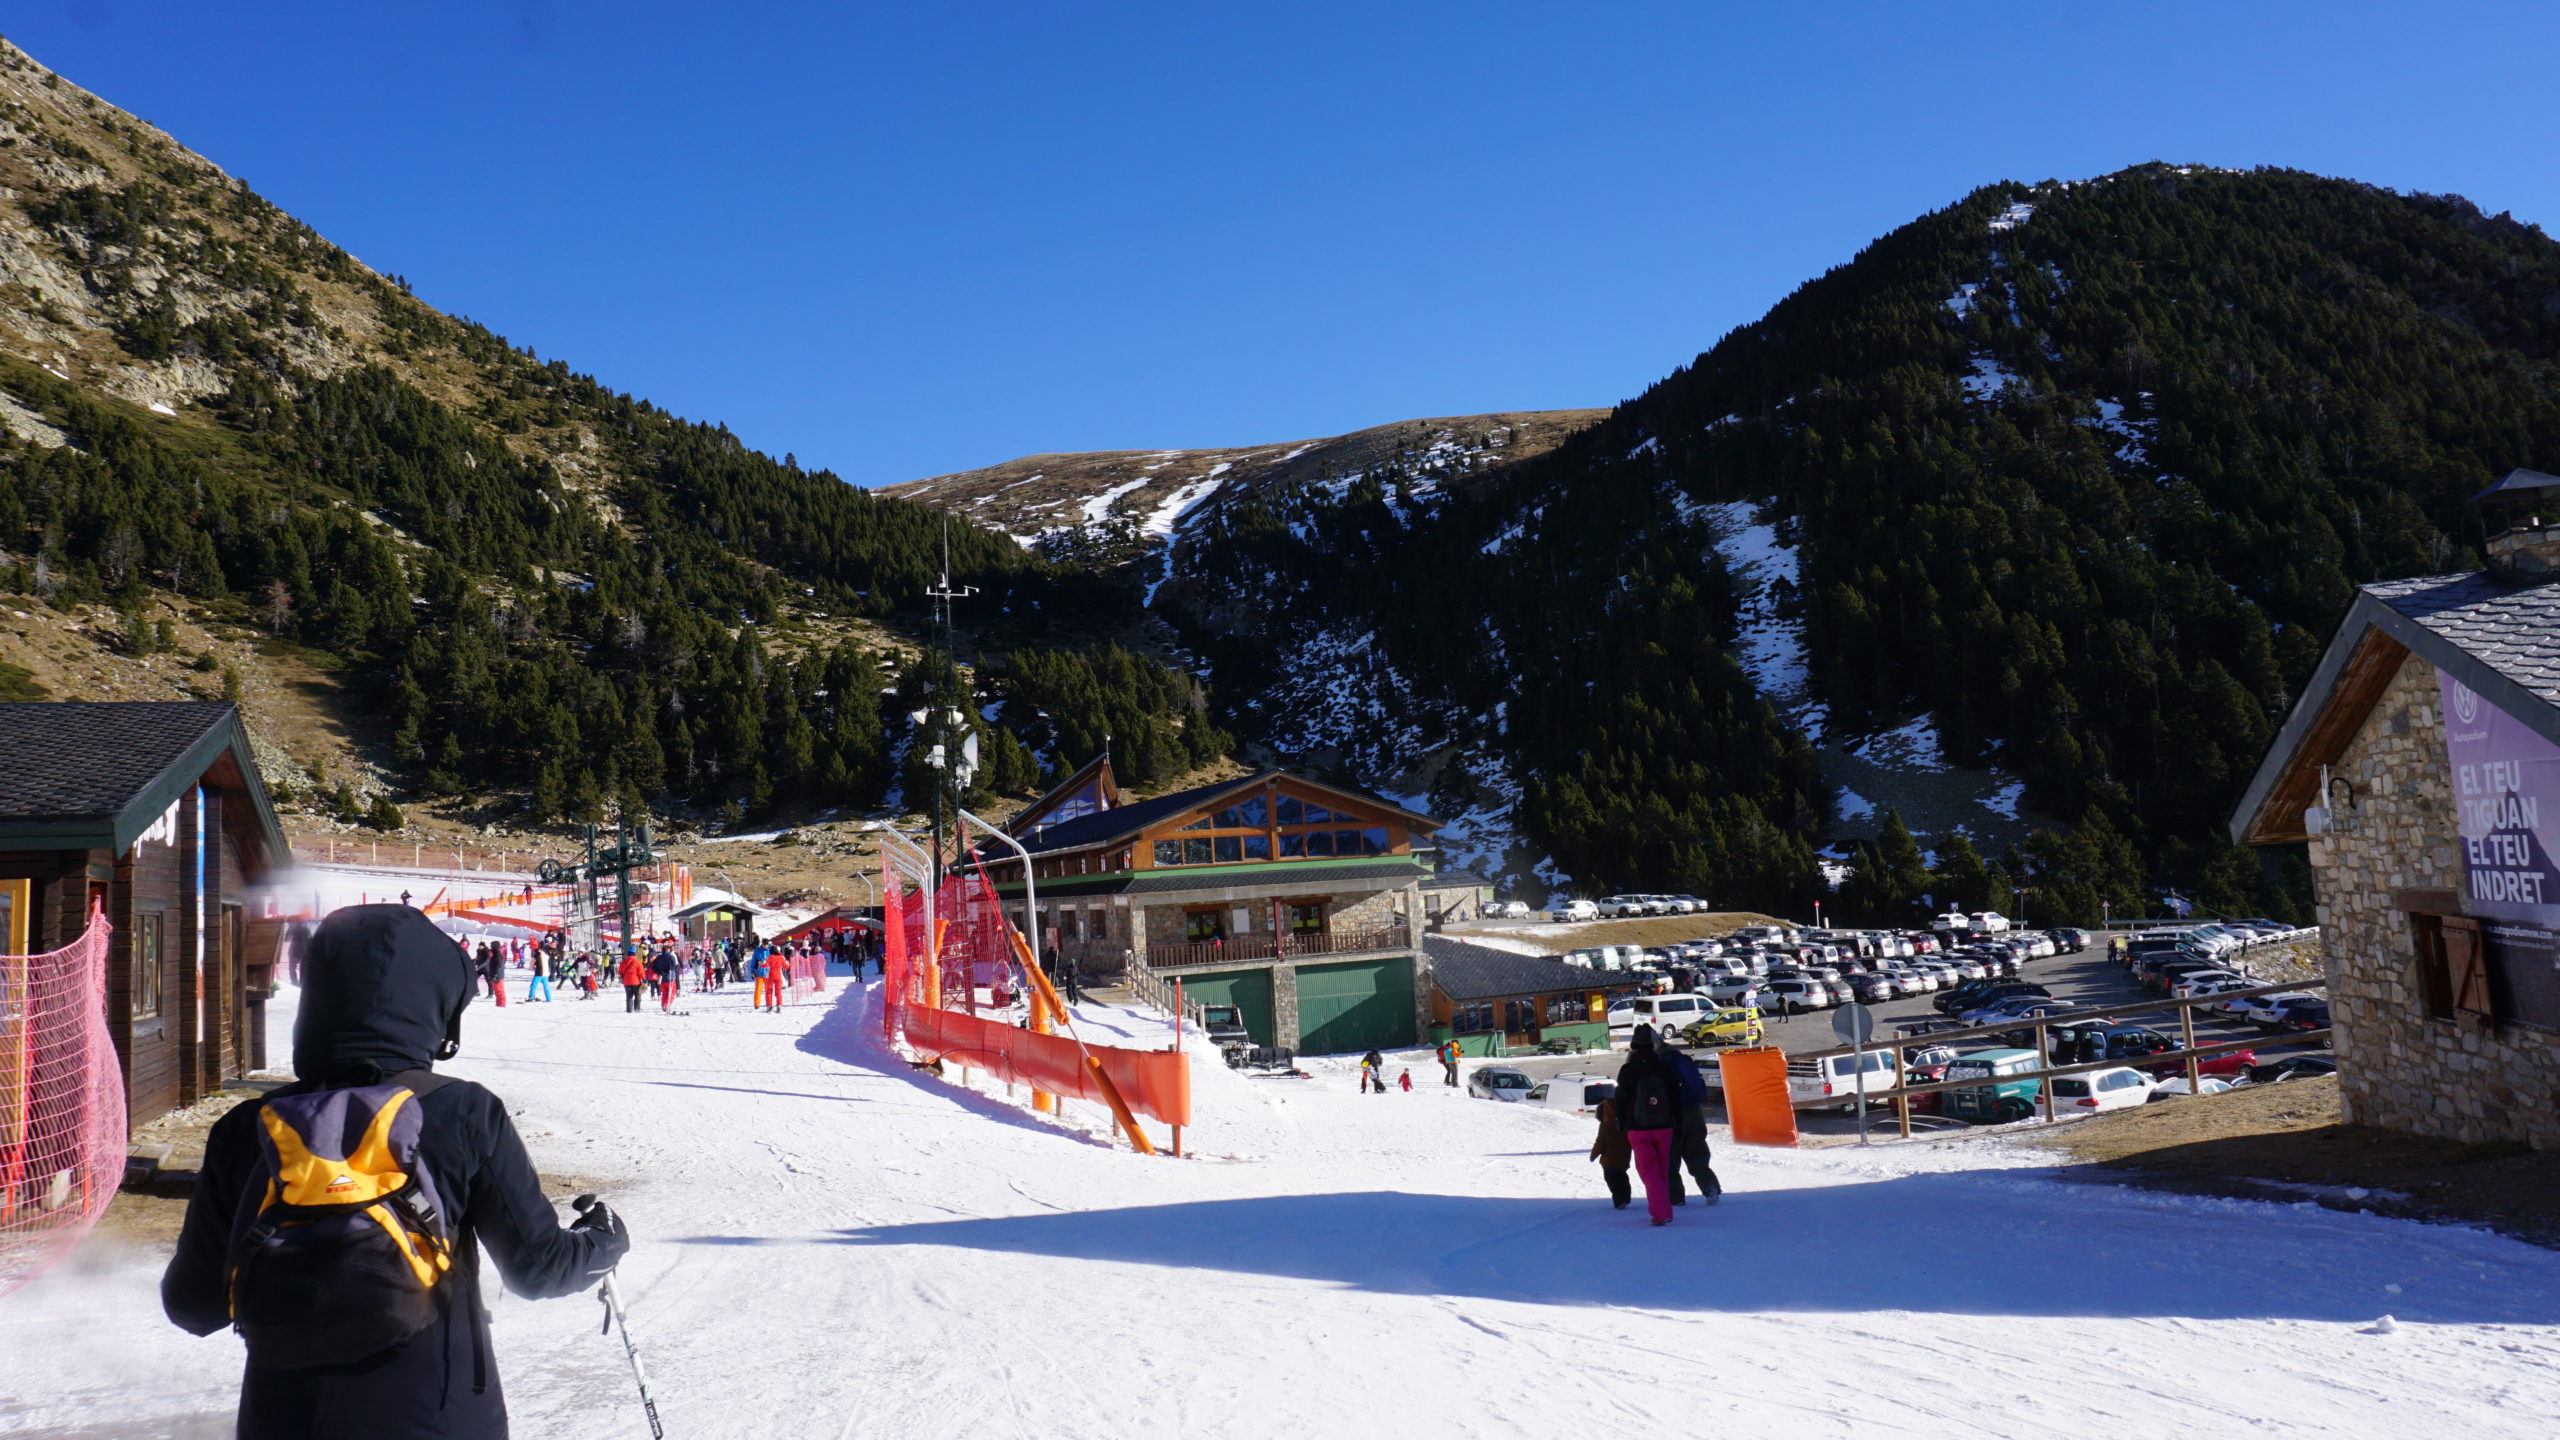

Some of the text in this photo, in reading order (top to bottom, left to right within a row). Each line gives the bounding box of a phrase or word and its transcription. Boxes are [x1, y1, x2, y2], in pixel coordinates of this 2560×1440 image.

[2460, 760, 2520, 795] EL TEU
[2464, 796, 2539, 830] TIGUAN
[2467, 834, 2530, 867] EL TEU
[2471, 869, 2545, 904] INDRET
